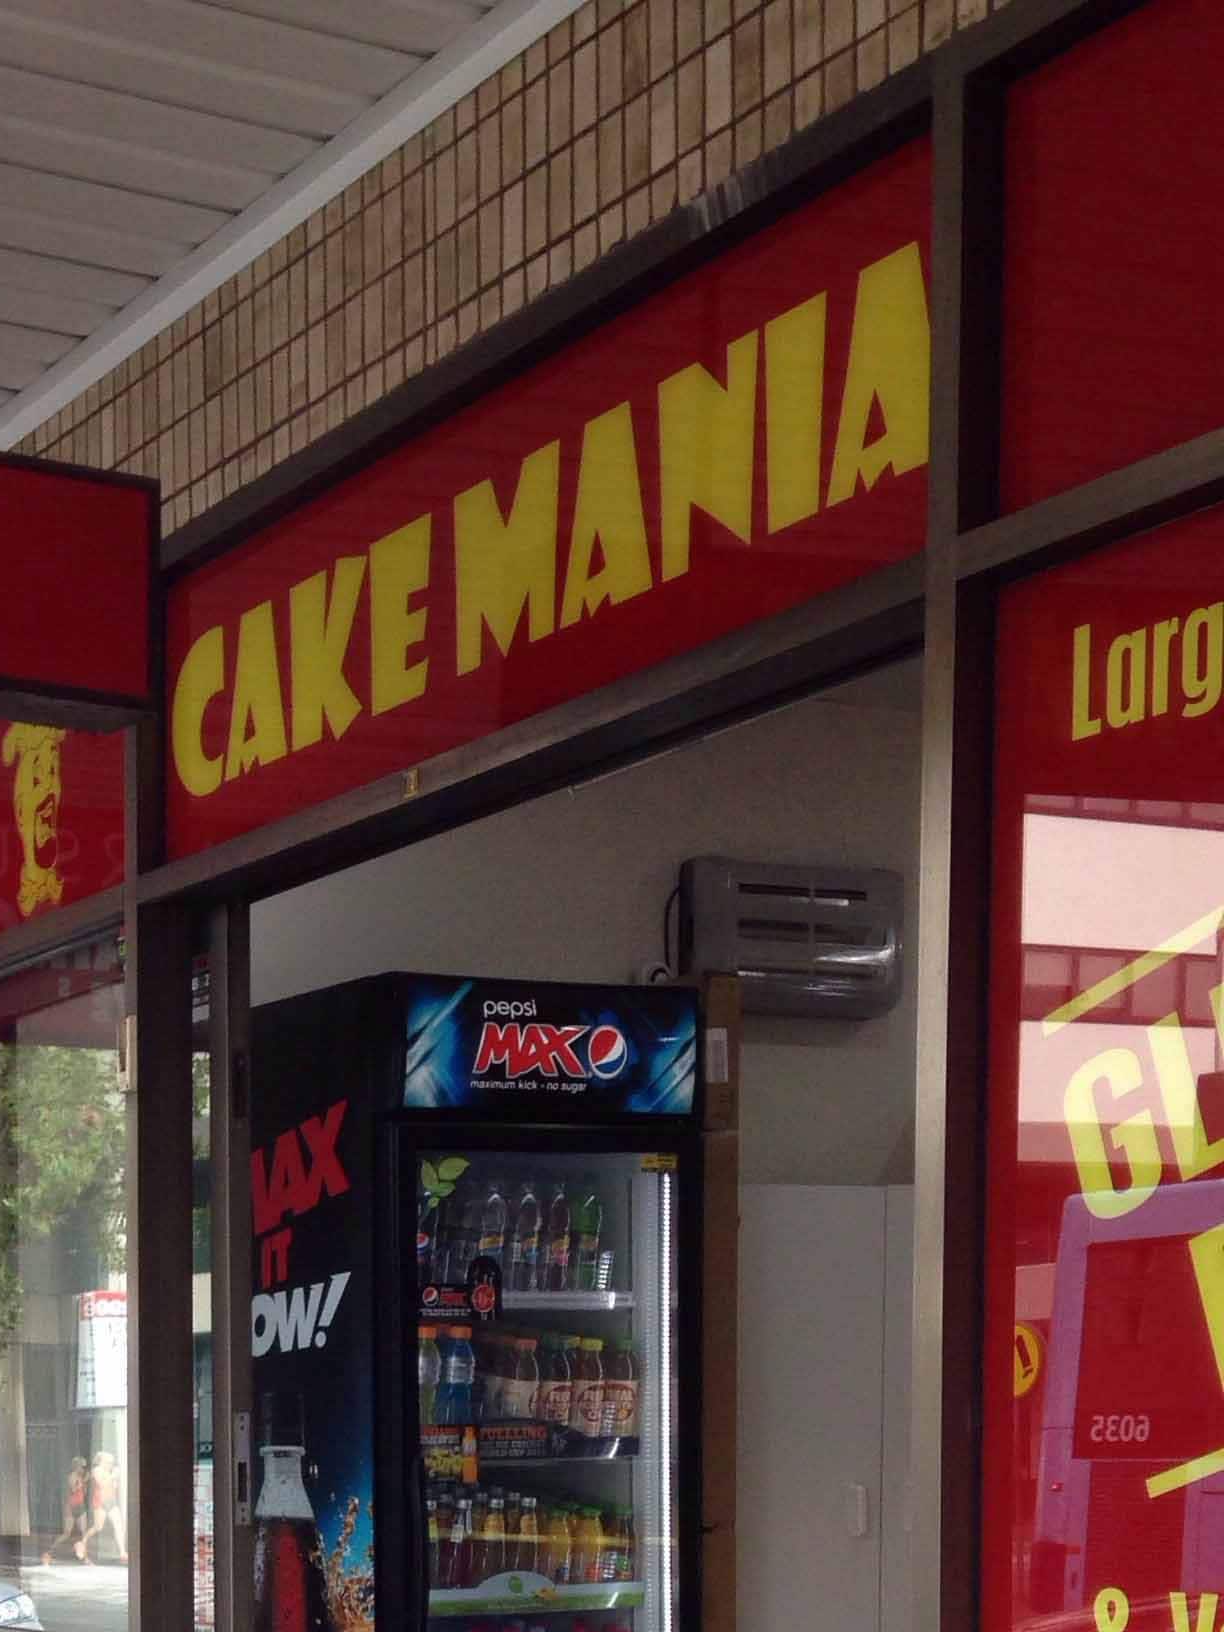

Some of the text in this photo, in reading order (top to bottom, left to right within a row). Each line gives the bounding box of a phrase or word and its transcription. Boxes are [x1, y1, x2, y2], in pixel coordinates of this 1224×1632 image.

[172, 241, 931, 797] CAKE MANIA
[482, 999, 537, 1020] pepsi
[472, 1021, 591, 1078] MAX
[469, 1079, 517, 1091] maximum
[518, 1079, 538, 1090] kick
[1063, 984, 1224, 1219] GL
